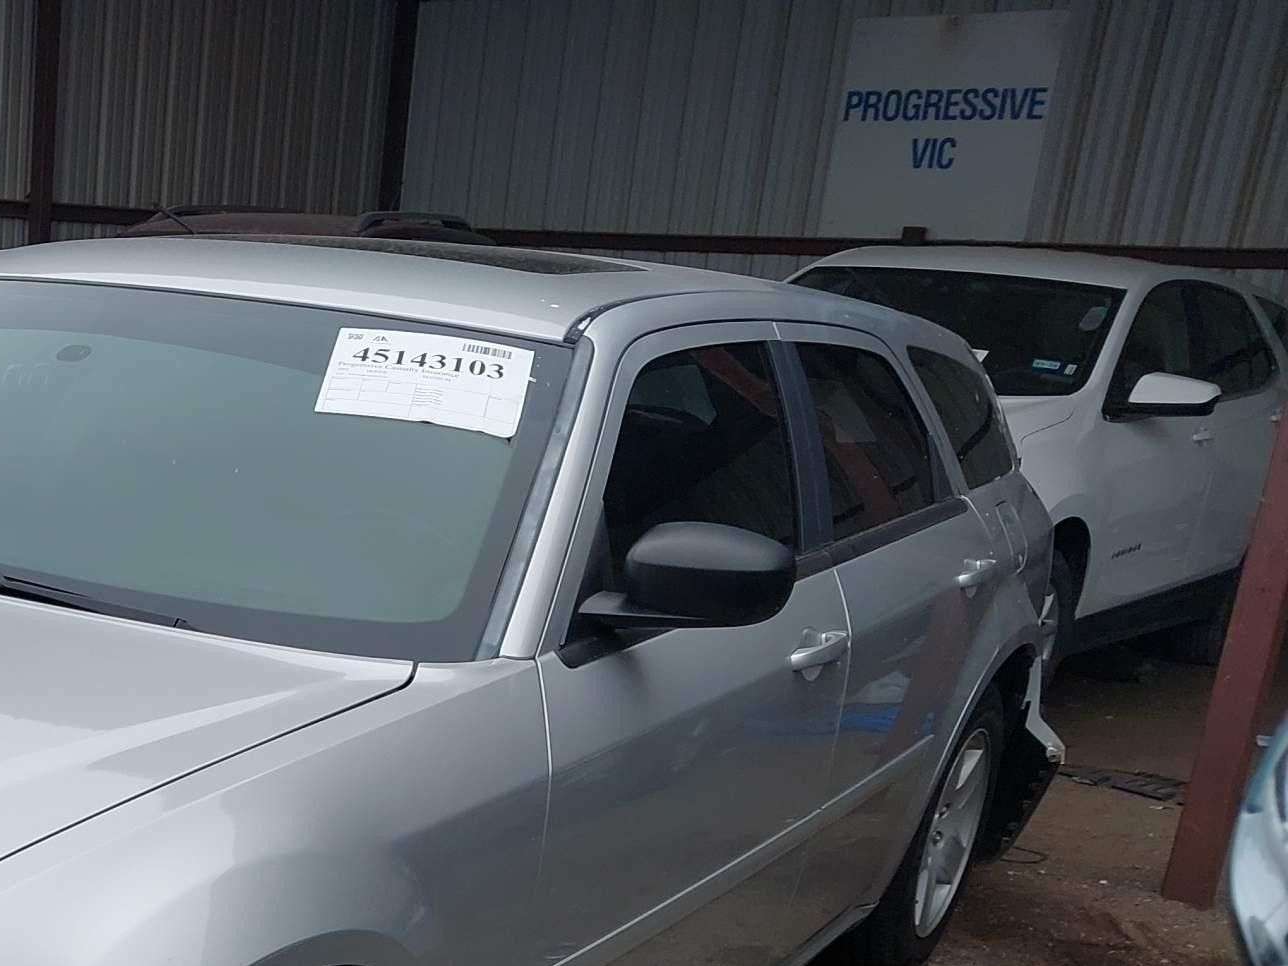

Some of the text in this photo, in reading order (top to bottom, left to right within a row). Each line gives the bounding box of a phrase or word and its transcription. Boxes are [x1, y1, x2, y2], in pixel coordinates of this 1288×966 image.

[843, 87, 1049, 122] PROGRESSIVE
[911, 137, 957, 170] VIC
[352, 347, 505, 380] 45143103
